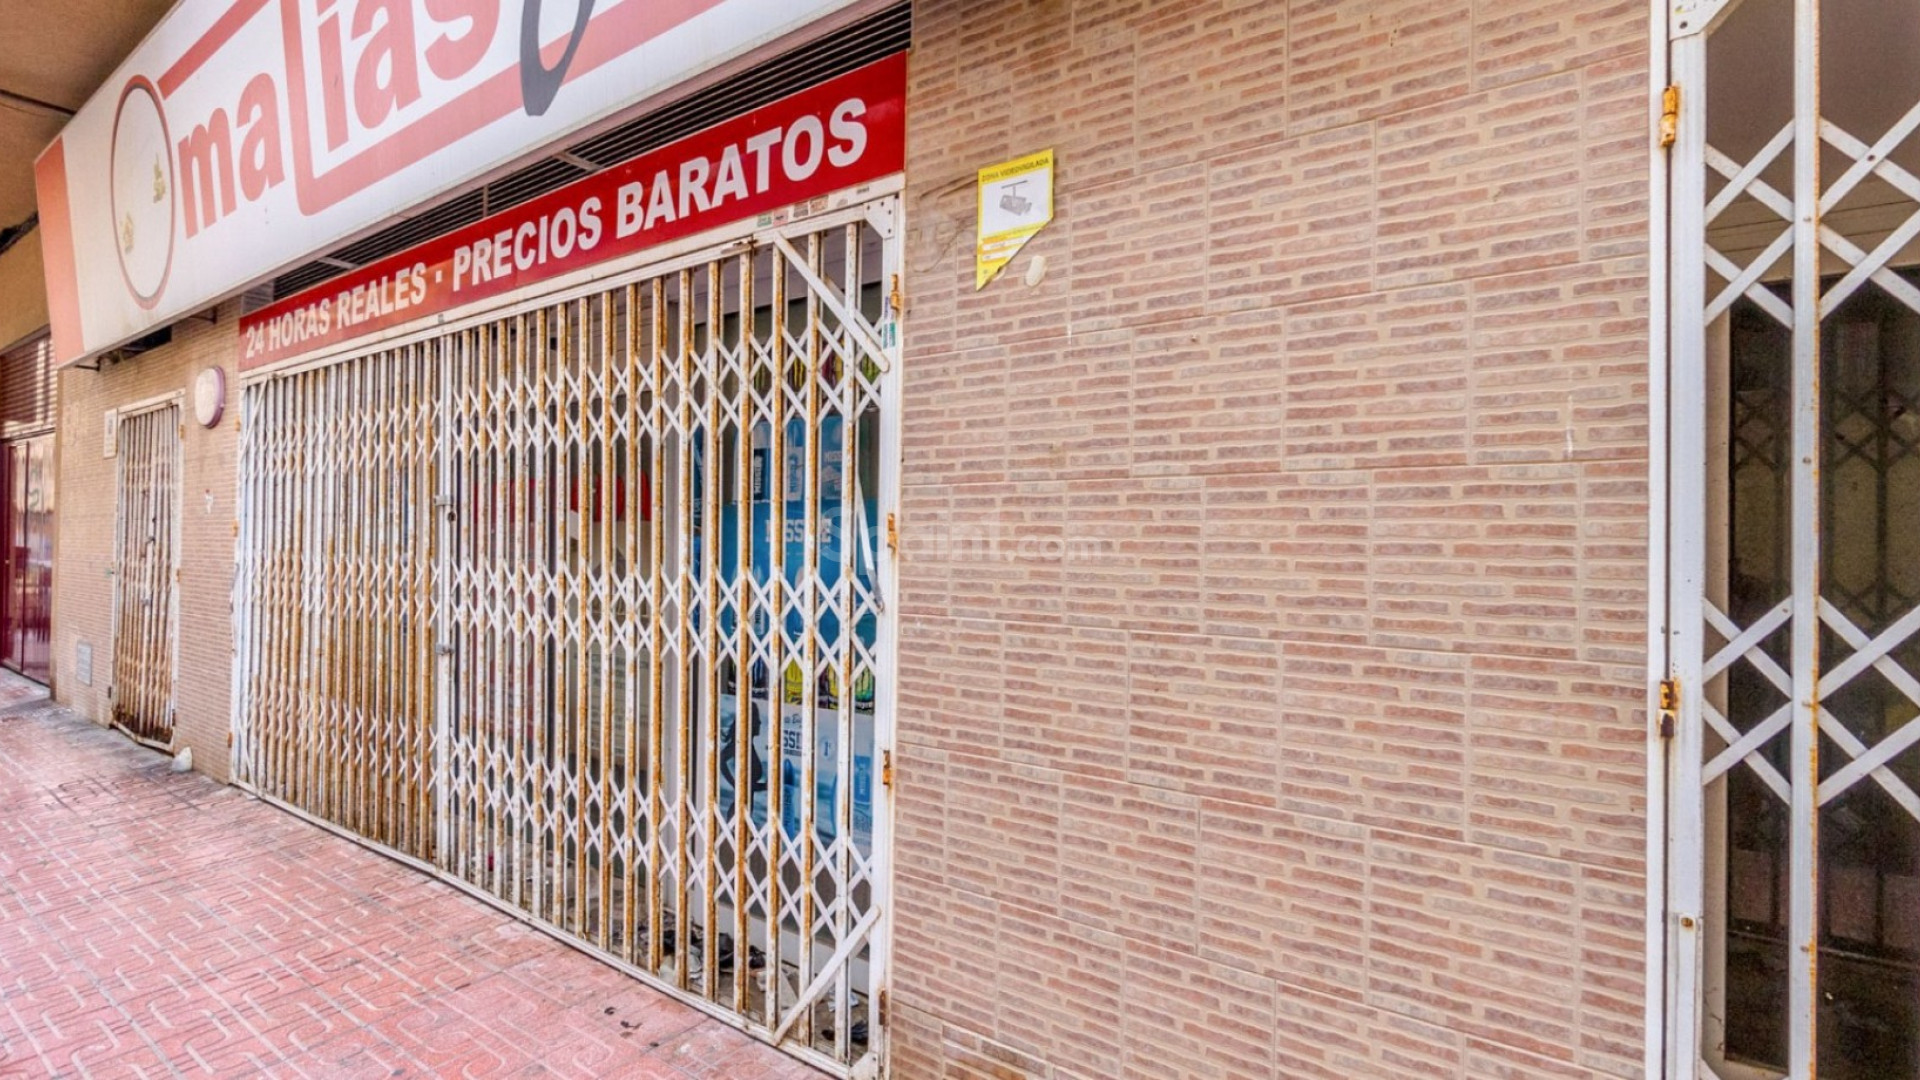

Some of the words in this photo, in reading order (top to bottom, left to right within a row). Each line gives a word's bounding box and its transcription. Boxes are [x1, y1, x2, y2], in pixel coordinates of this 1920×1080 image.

[246, 325, 265, 358] 24
[269, 298, 331, 351] HORAS
[337, 262, 427, 330] REALES
[453, 196, 602, 292] PRECIOS
[616, 97, 868, 240] BARATOS
